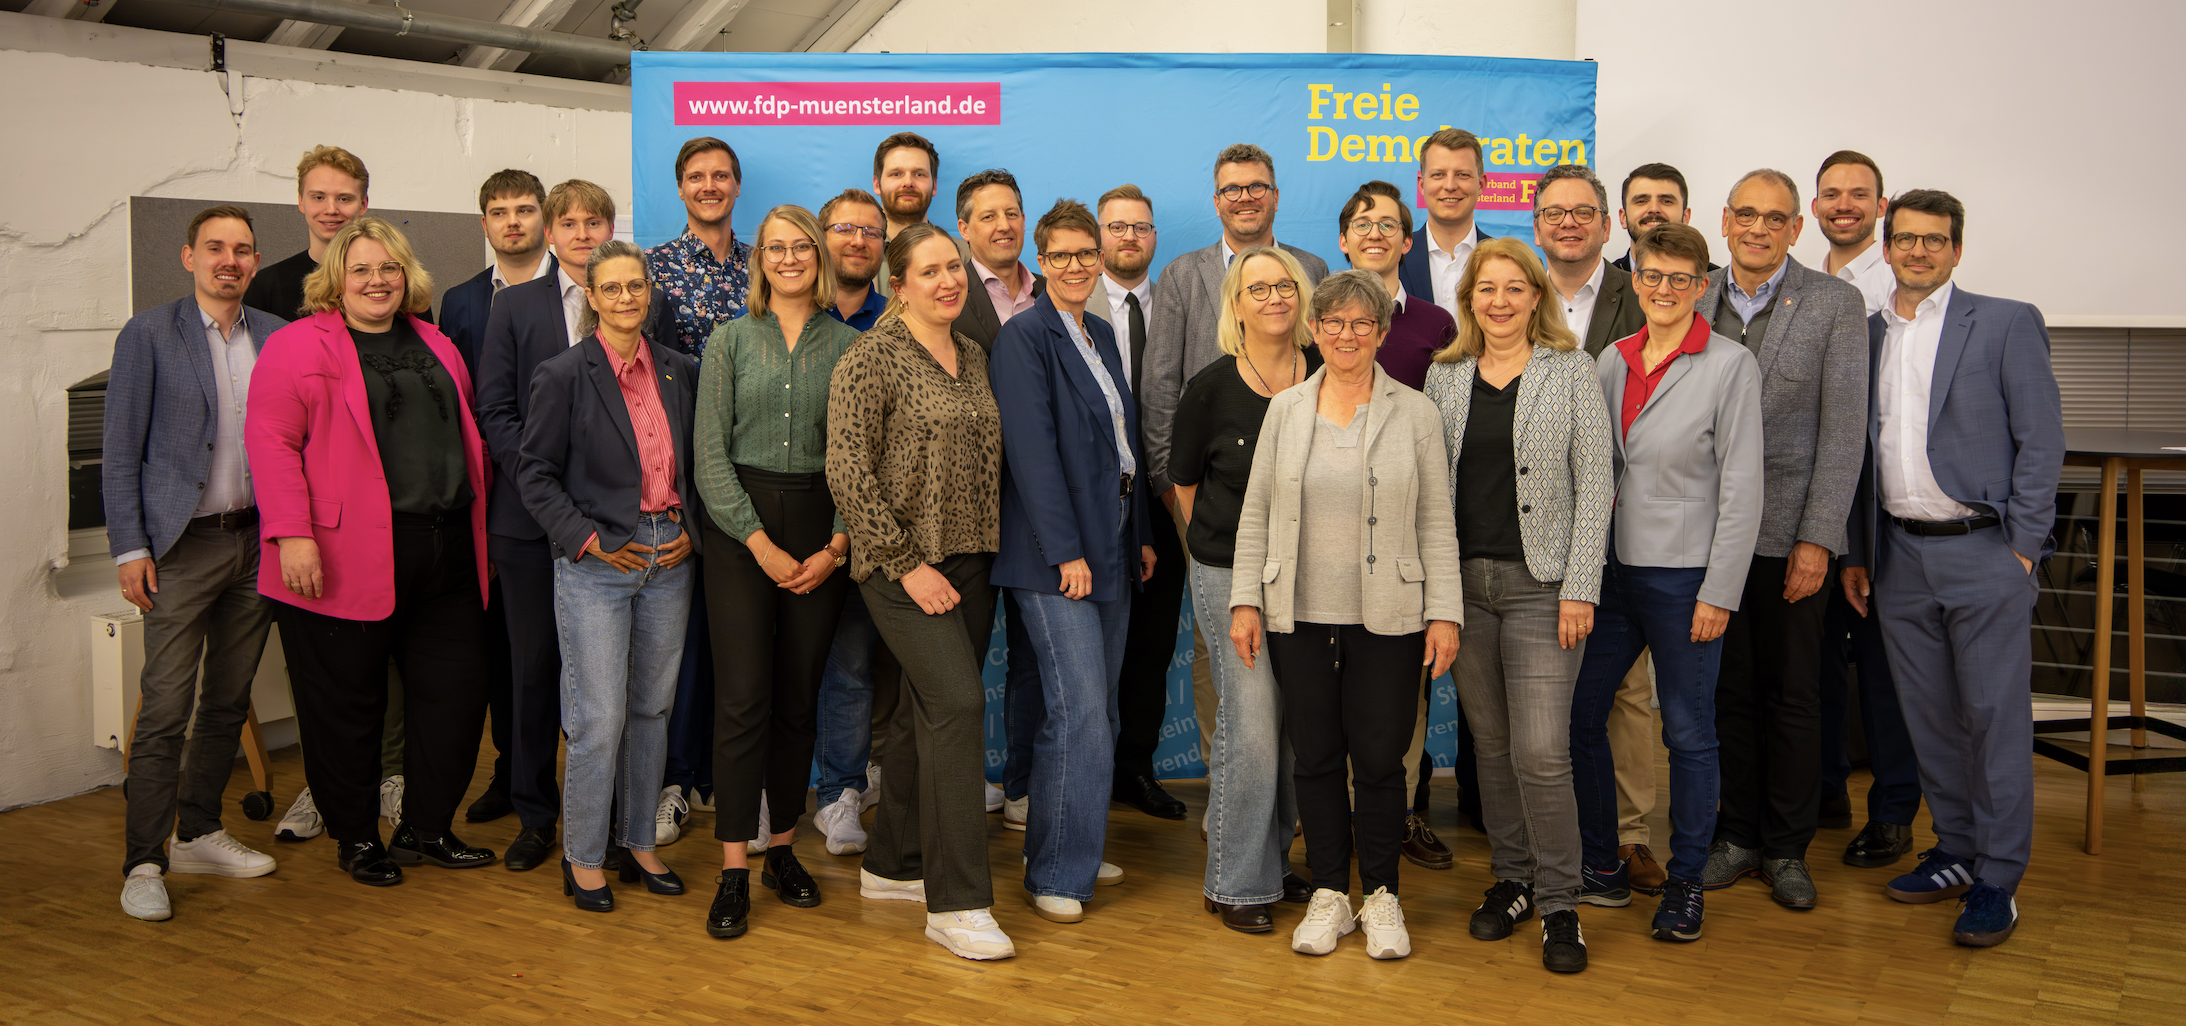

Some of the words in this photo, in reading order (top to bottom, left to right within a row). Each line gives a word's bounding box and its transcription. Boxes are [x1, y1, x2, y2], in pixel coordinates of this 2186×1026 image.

[688, 95, 986, 119] www.fdp-muensterland.de
[1308, 83, 1420, 121] Freie
[1306, 125, 1588, 166] Dematen
